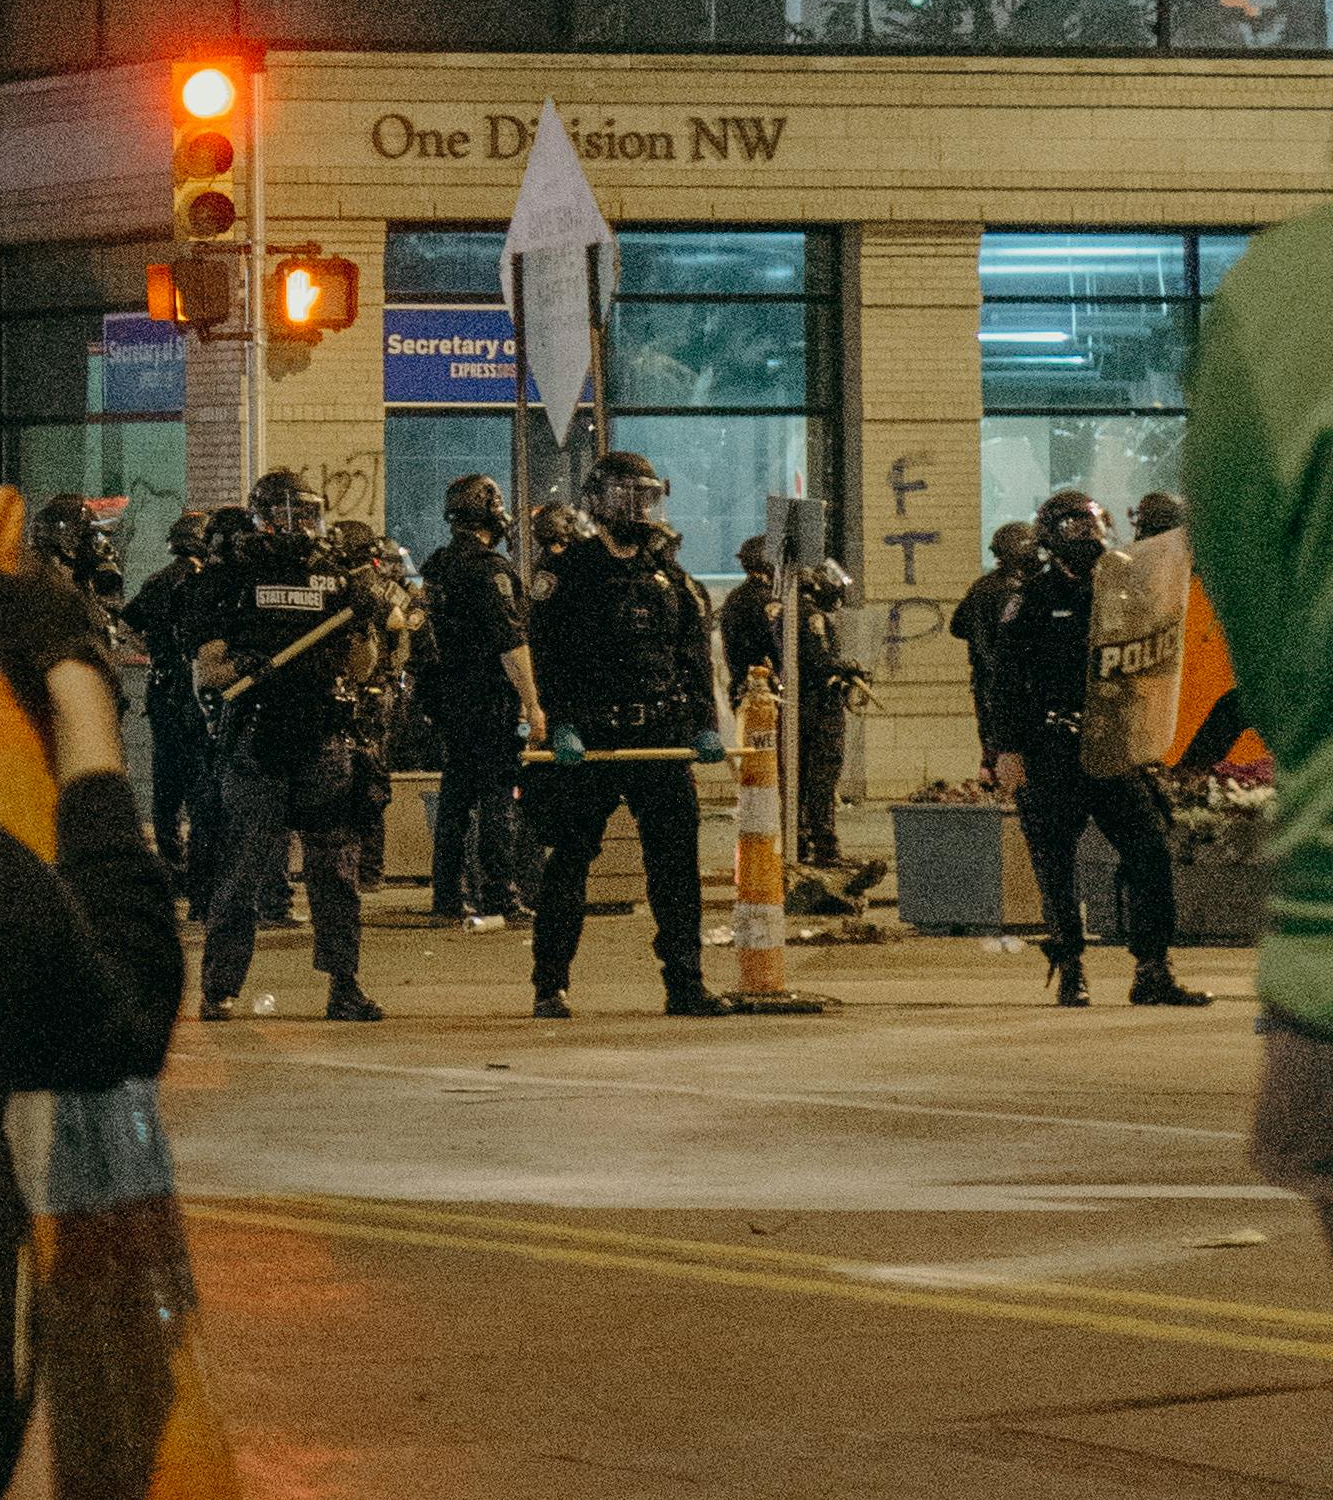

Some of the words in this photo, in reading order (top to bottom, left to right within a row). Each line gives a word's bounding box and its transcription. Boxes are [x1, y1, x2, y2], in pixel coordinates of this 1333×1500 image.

[371, 113, 471, 160] One
[485, 114, 674, 161] Diision
[689, 115, 788, 162] NW
[387, 334, 499, 360] Secretary
[259, 591, 287, 605] STATE
[287, 591, 321, 606] POLICE
